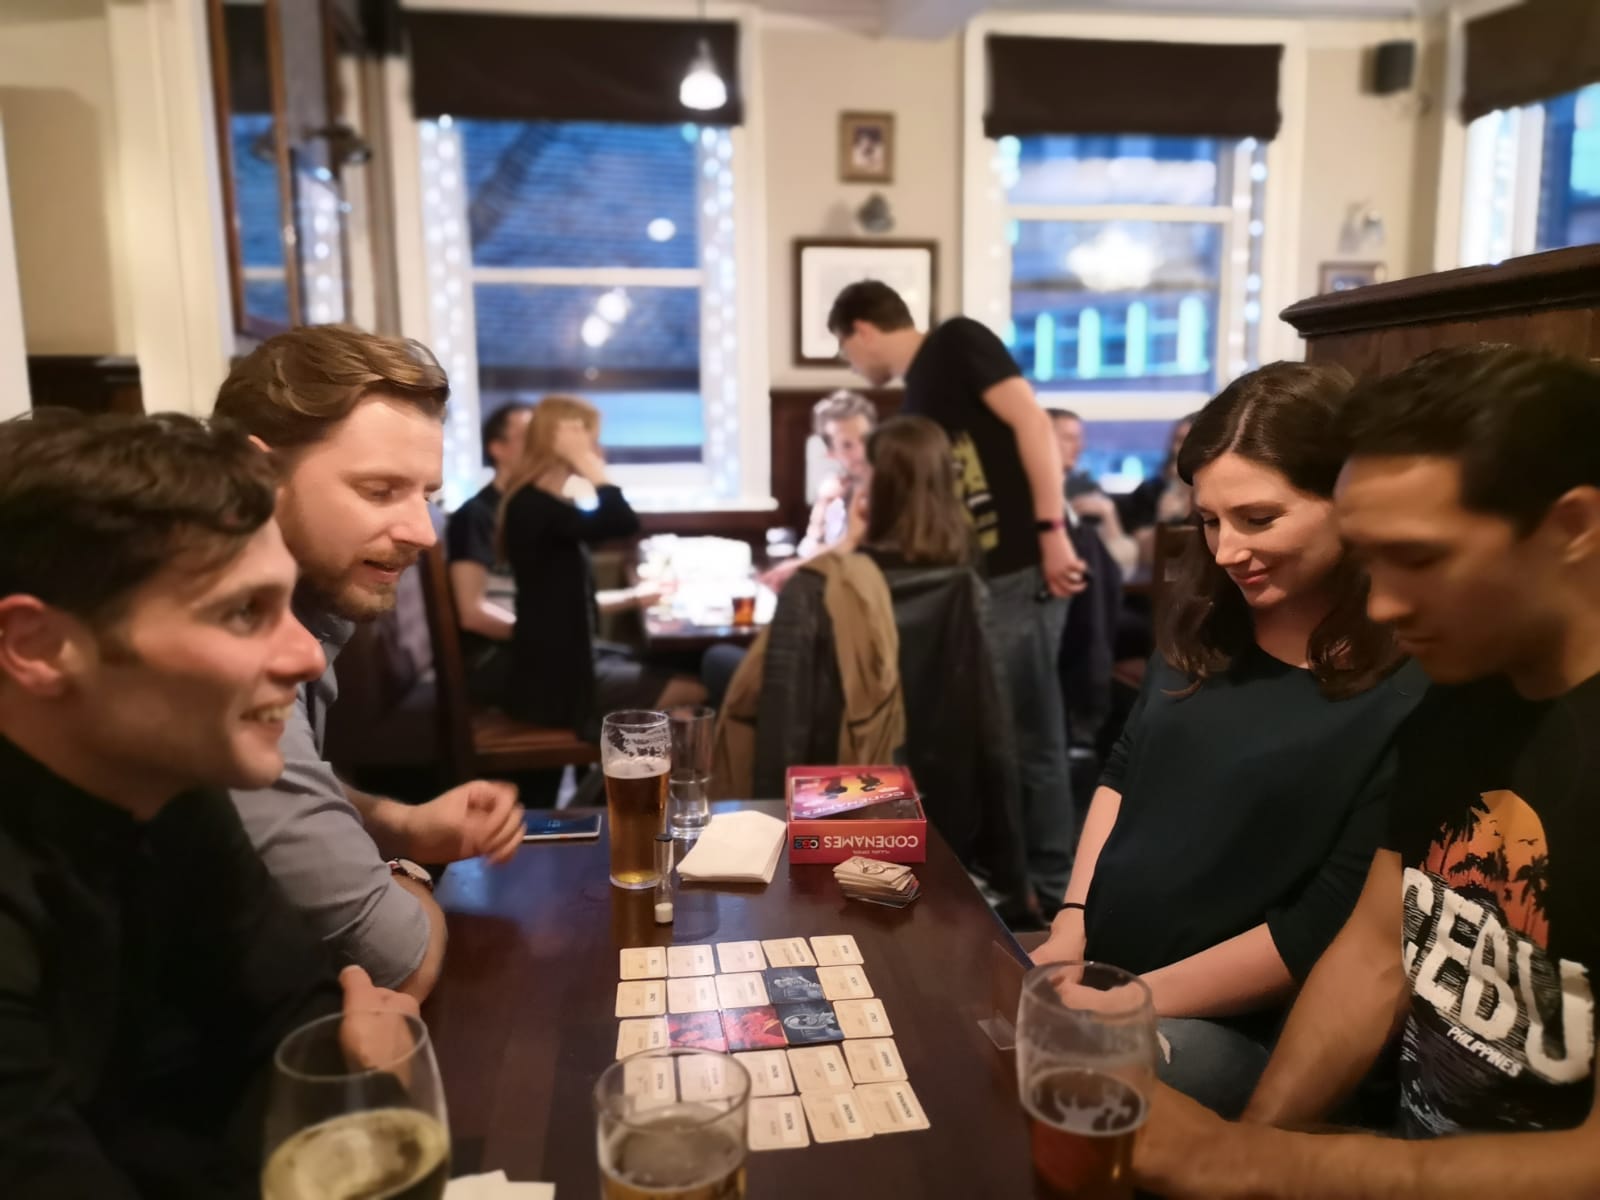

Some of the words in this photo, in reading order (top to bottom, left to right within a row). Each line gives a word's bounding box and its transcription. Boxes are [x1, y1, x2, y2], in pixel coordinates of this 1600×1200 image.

[823, 835, 919, 849] CODENAMES
[1402, 867, 1595, 1084] CEBU
[1447, 1026, 1523, 1078] PHILIPPINES
